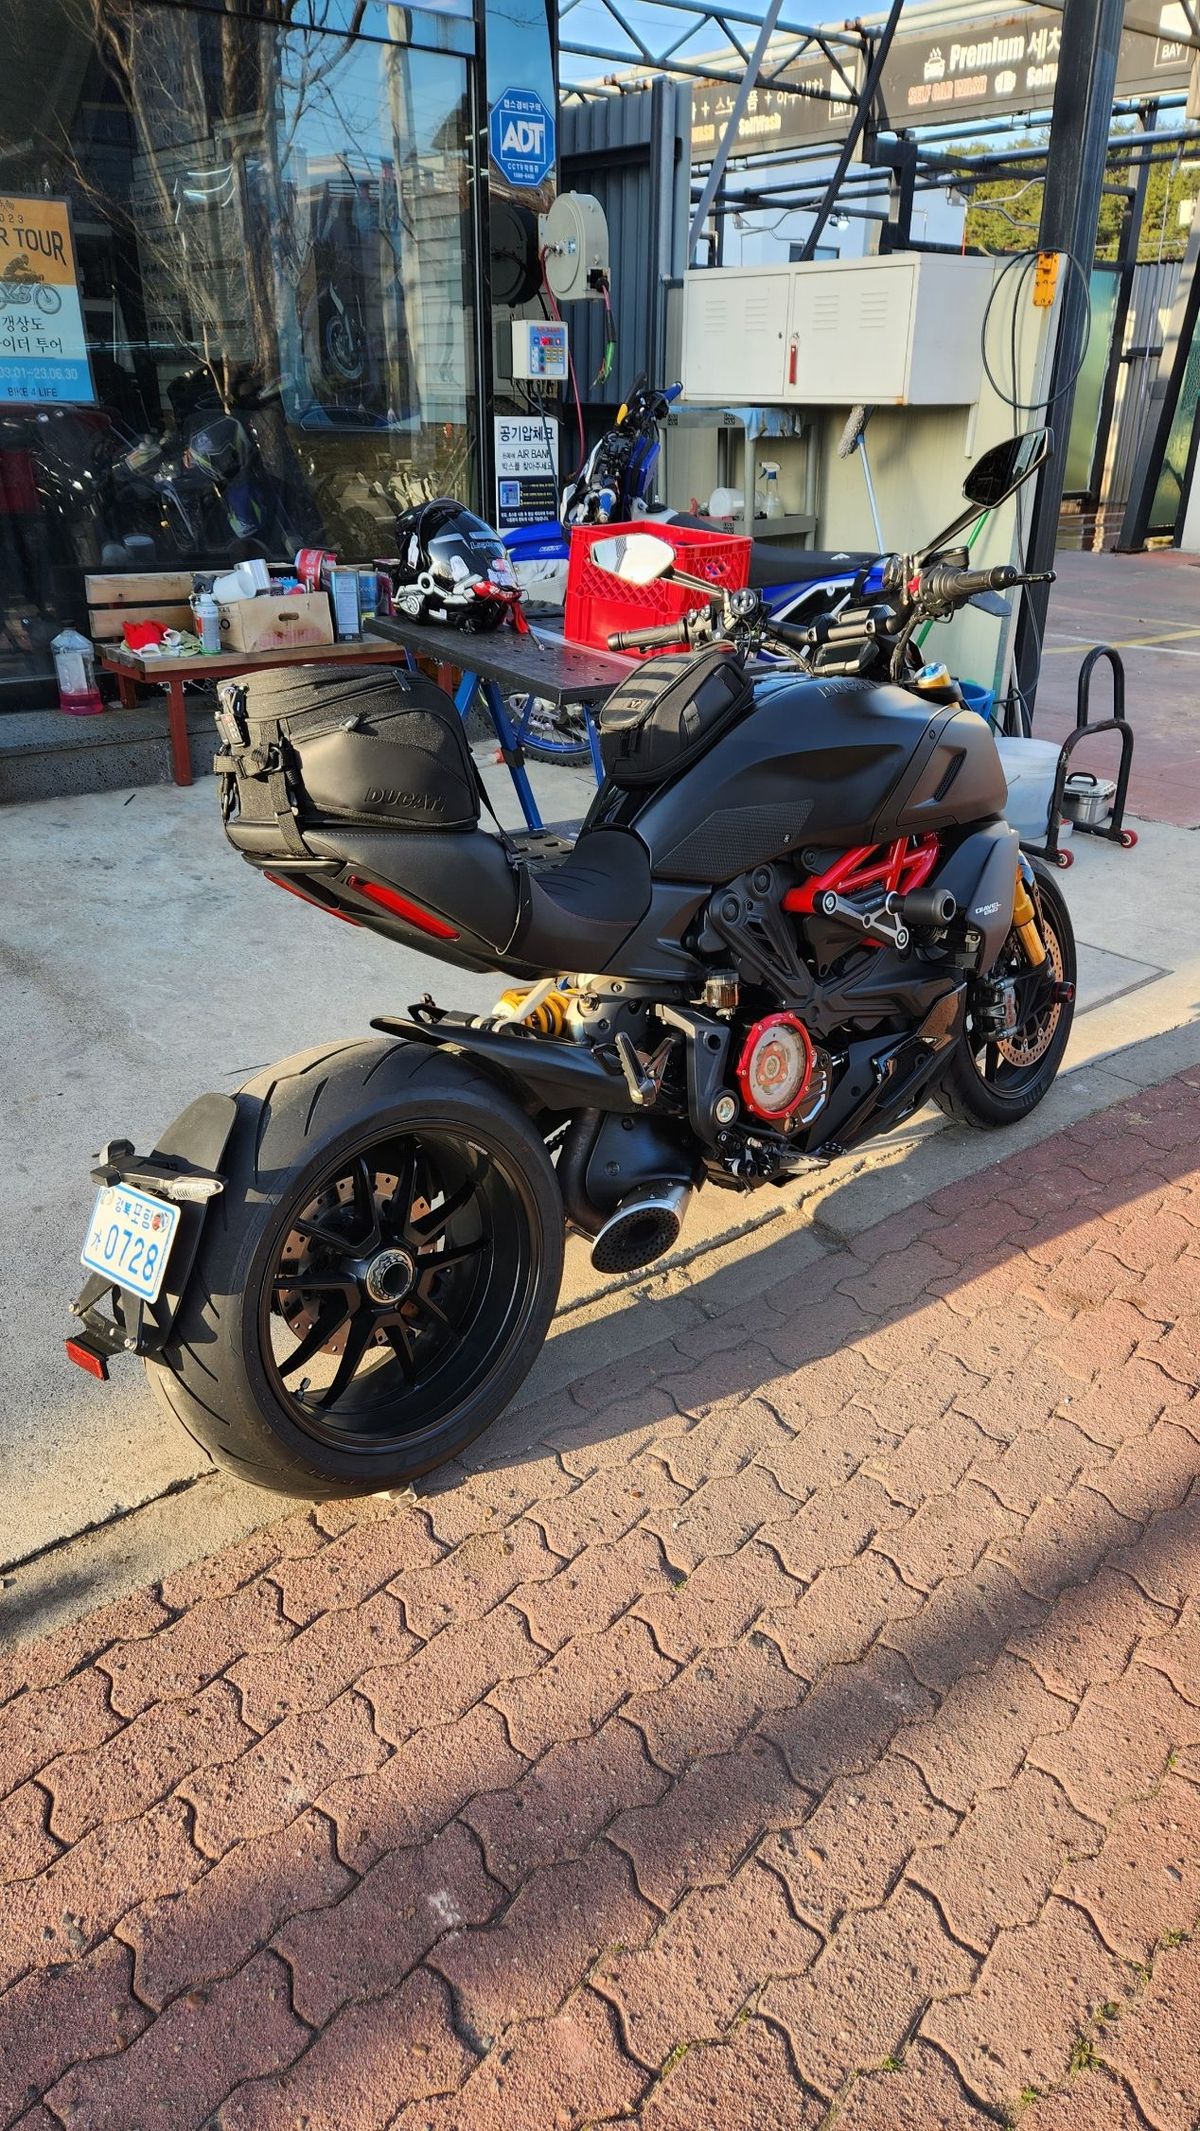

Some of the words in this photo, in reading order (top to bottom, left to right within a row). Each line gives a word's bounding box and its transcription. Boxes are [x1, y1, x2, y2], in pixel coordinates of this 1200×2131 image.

[950, 35, 1025, 71] Premium
[1161, 42, 1182, 58] BAY
[908, 84, 931, 105] SELF
[931, 81, 954, 102] CAR
[954, 75, 987, 98] WASH
[833, 102, 848, 114] BAY
[739, 112, 782, 135] SelfWash
[502, 121, 545, 154] ADT
[13, 228, 67, 266] TOUR
[2, 315, 45, 332] 갱상도
[36, 337, 63, 354] 투어
[7, 387, 29, 397] BIKE
[38, 387, 58, 397] LIFE
[500, 425, 554, 442] 공기압체크
[517, 449, 530, 459] AIR
[365, 786, 447, 812] DUCATI
[975, 901, 1002, 914] DIAVEL
[130, 1202, 154, 1230] 포항
[104, 1224, 159, 1281] 0728
